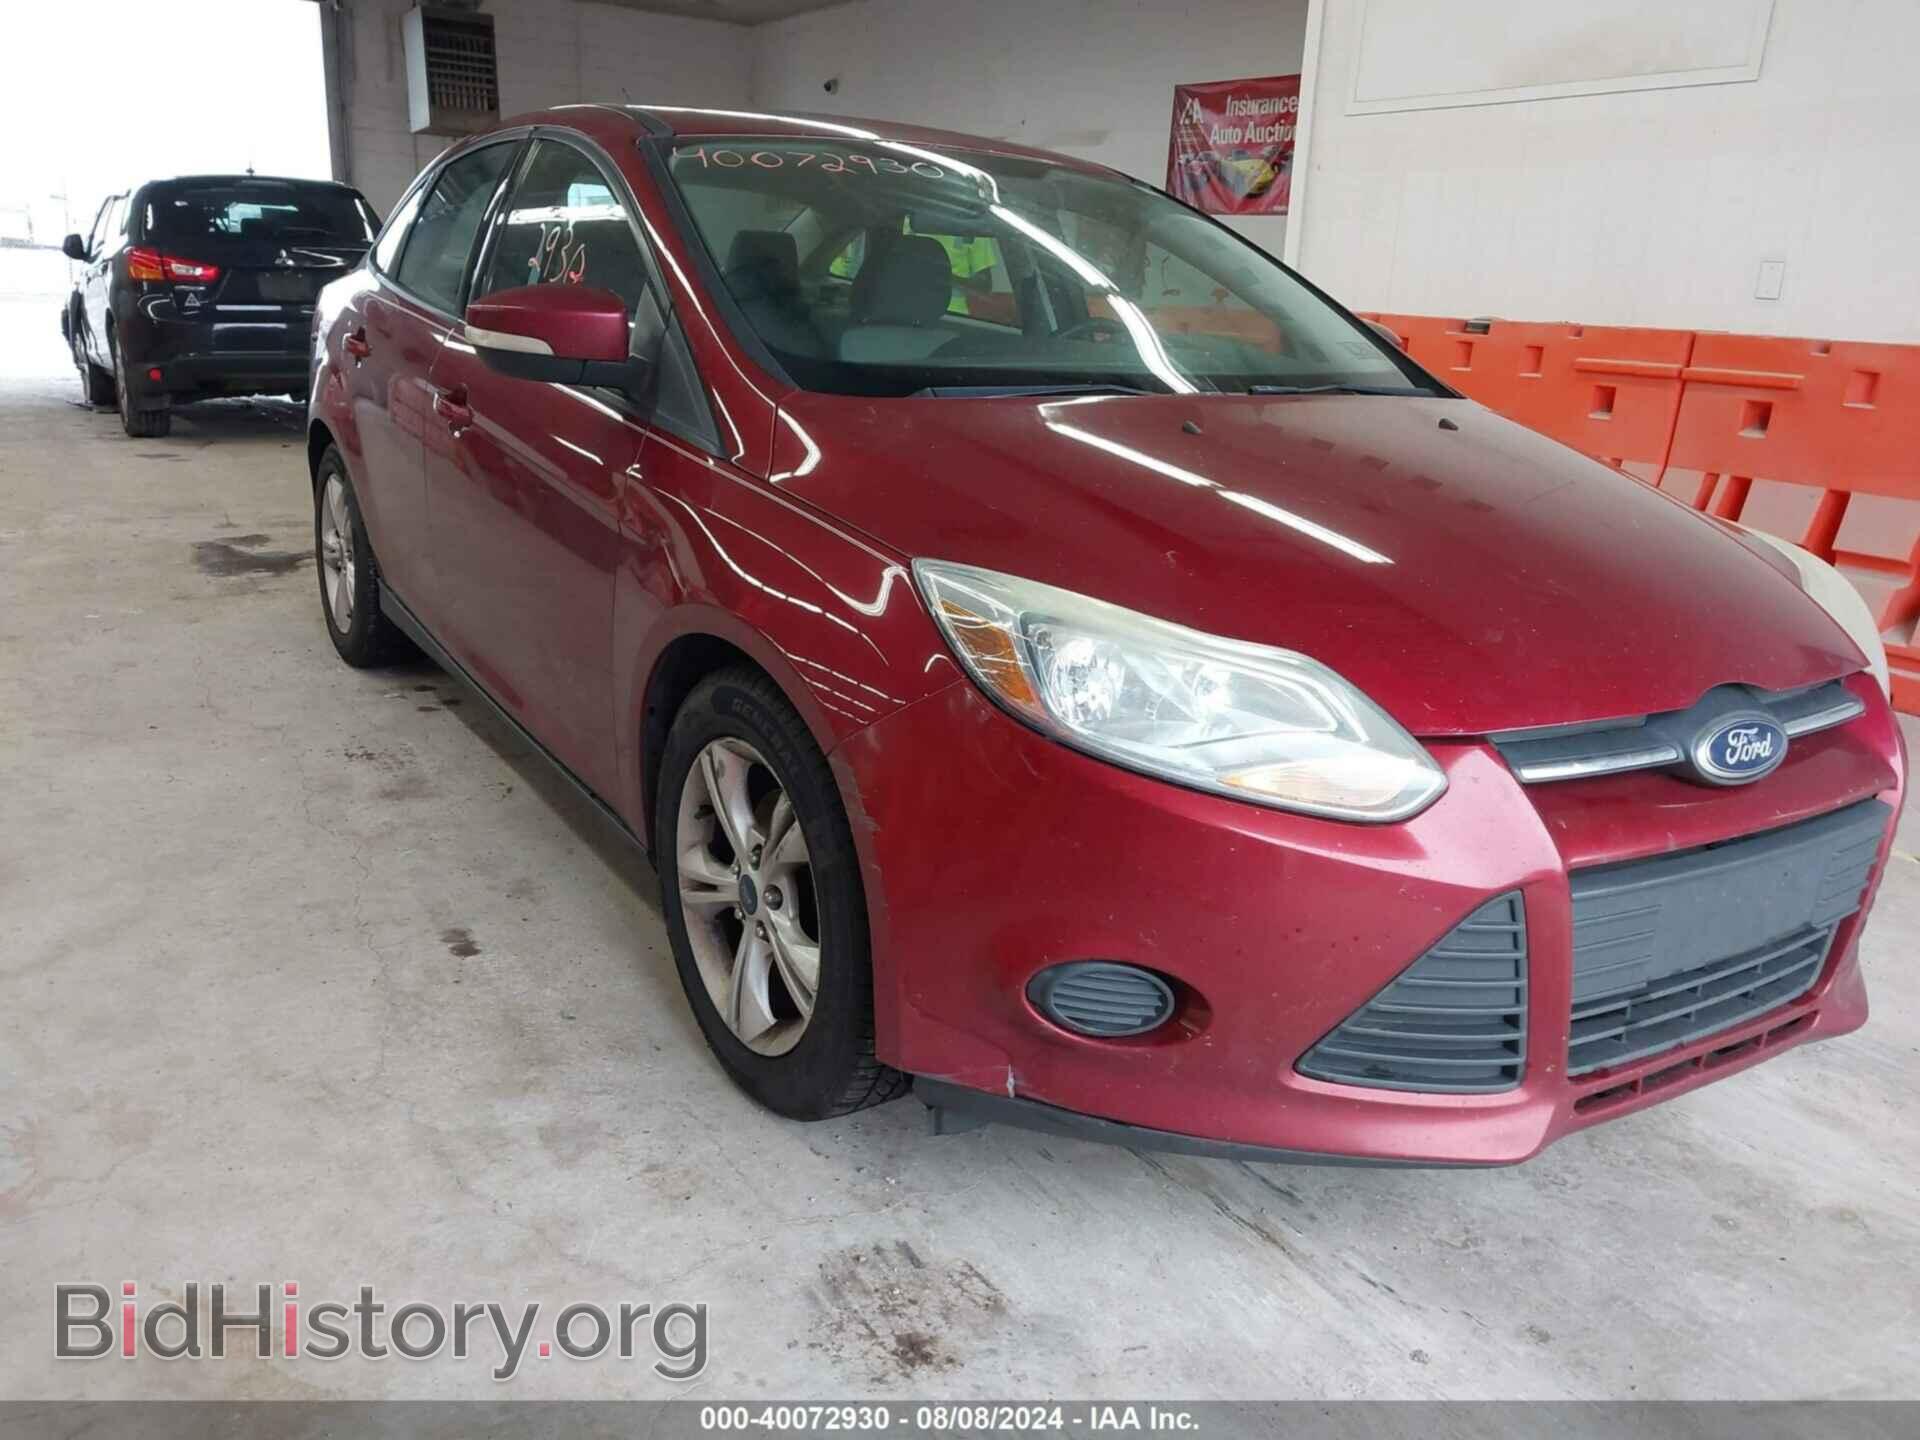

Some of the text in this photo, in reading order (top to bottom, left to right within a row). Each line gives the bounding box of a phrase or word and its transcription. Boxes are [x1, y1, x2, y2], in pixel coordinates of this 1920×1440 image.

[1225, 94, 1299, 117] Insurance
[1209, 123, 1243, 146] Auto
[1725, 727, 1773, 765] Ford
